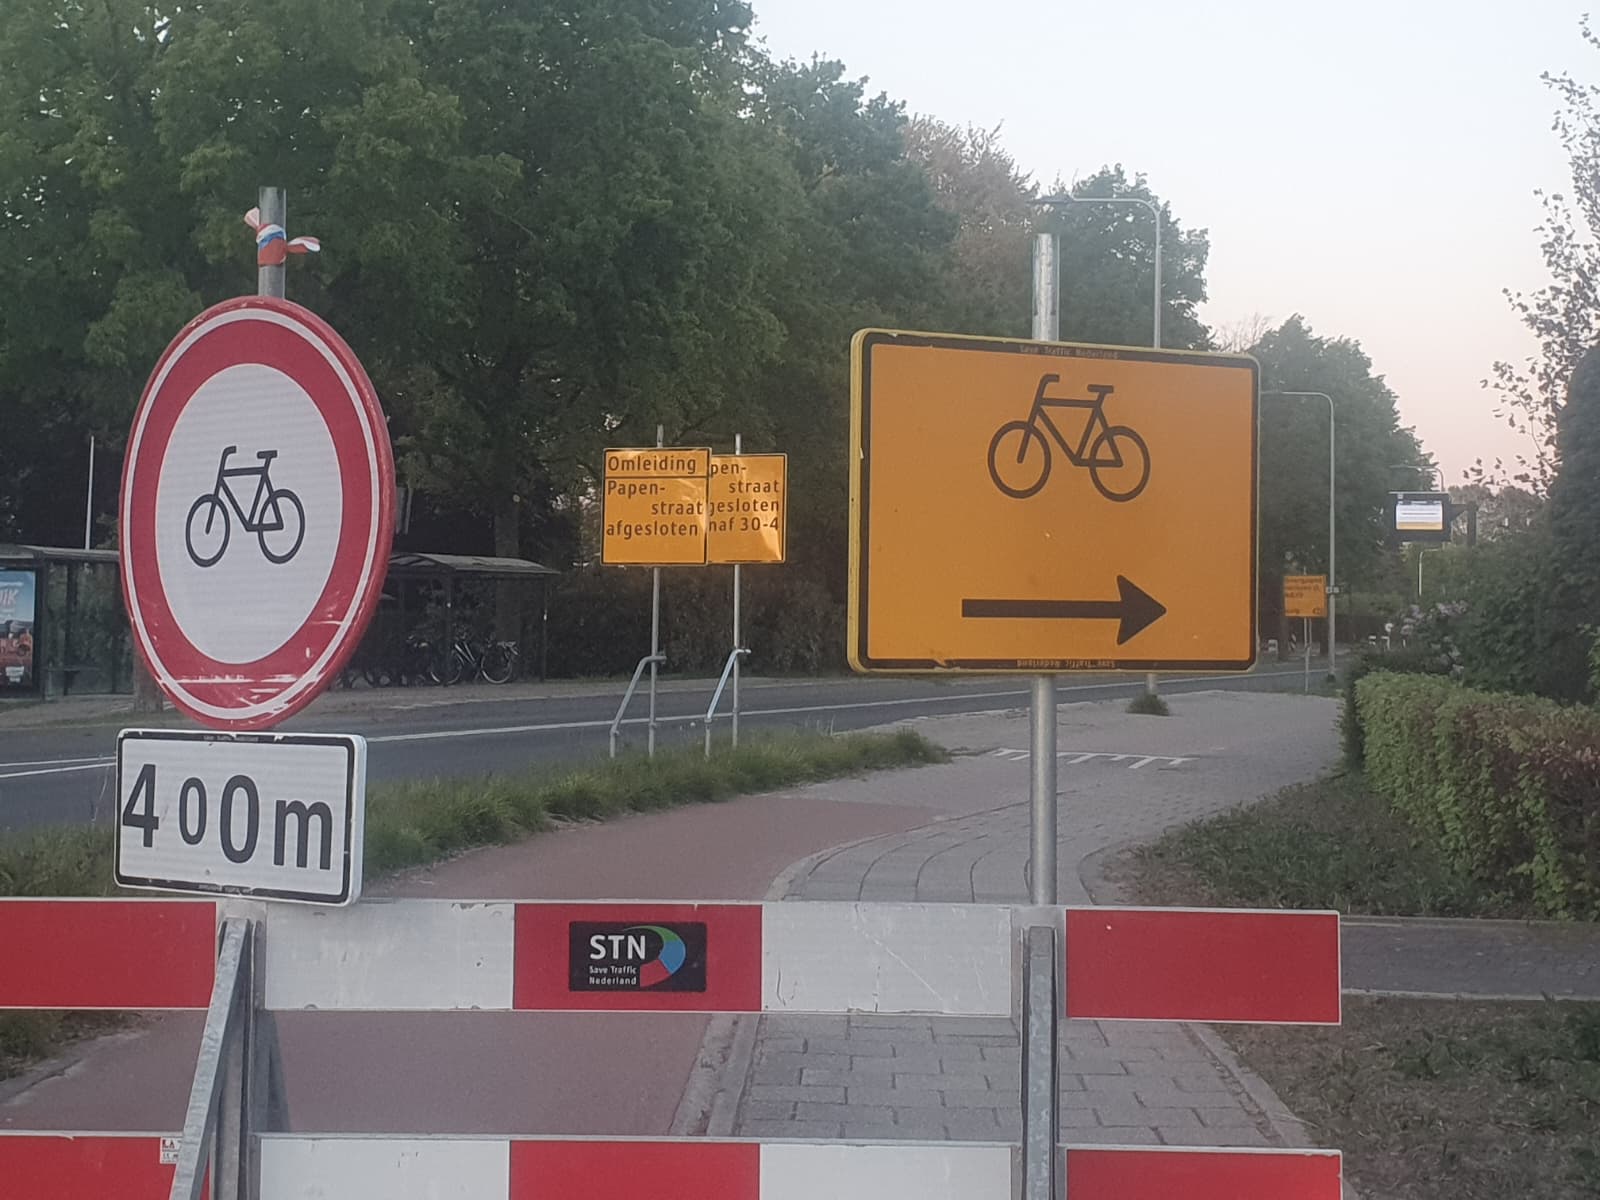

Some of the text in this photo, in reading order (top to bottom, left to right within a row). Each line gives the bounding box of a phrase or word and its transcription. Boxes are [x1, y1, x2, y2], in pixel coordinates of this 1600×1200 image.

[608, 456, 696, 474] Omleiding
[607, 480, 665, 498] Papen-
[729, 480, 780, 494] straat
[651, 501, 704, 515] straat
[606, 520, 698, 540] afgesloten
[740, 516, 779, 532] 30-4
[589, 934, 646, 960] STN
[589, 965, 637, 975] Save Traffic
[589, 976, 637, 985] Nederland
